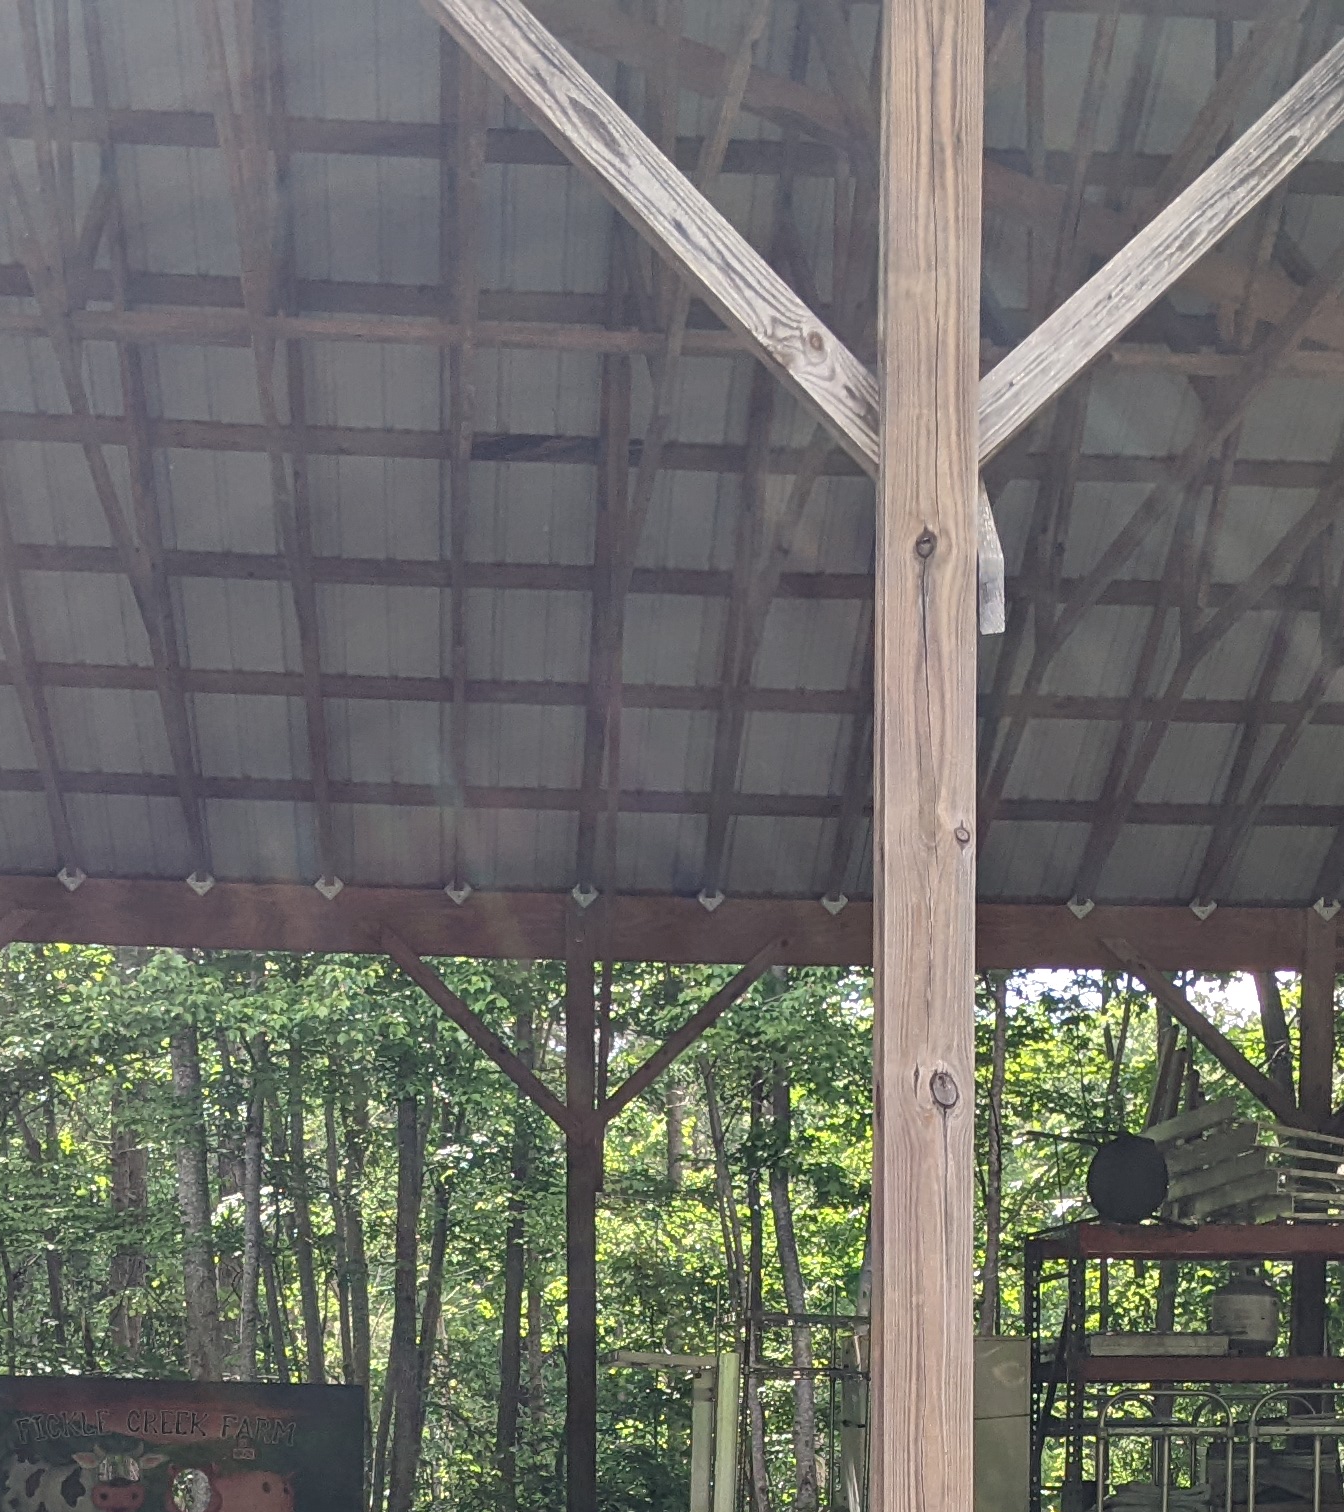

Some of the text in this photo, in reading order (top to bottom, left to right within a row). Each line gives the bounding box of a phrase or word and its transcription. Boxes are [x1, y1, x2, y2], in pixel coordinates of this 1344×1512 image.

[15, 1409, 297, 1446] FICKLE CREEK FARM
